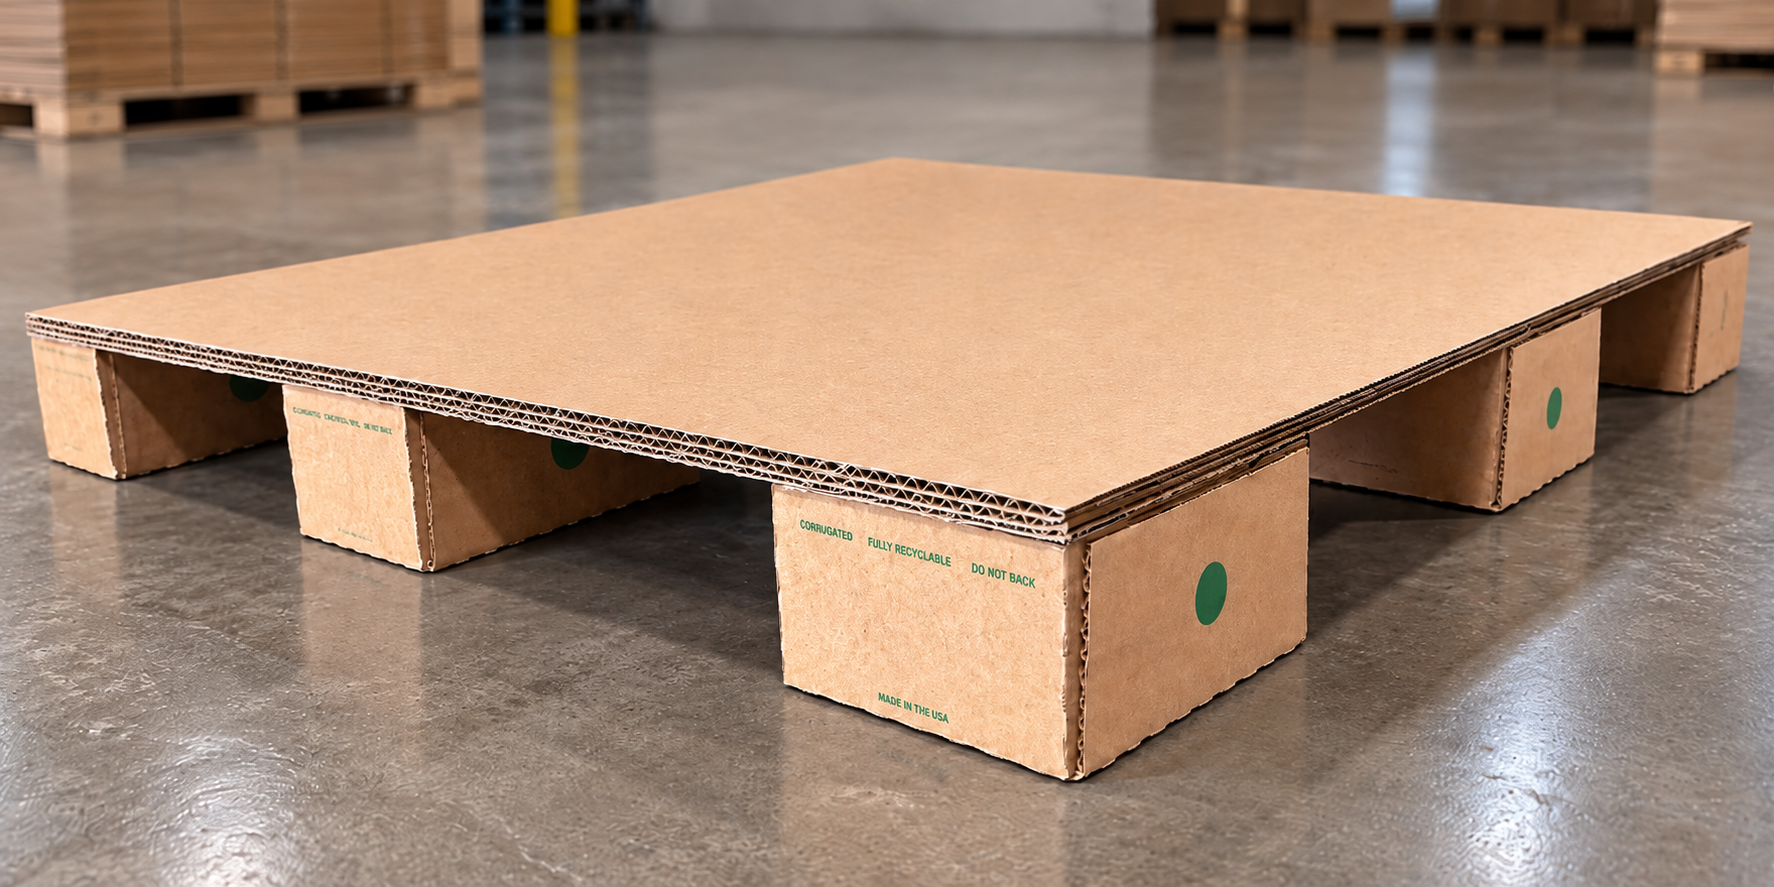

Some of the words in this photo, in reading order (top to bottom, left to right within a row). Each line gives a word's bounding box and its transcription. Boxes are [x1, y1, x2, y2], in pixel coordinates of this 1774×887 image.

[868, 537, 893, 551] FULLY
[895, 544, 951, 567] RECYCLABLE
[971, 563, 985, 575] DO
[988, 567, 1007, 581] NOT
[1009, 573, 1035, 588] BACK
[878, 692, 901, 707] MADE
[903, 701, 912, 712] IN
[914, 704, 930, 717] THE
[932, 710, 949, 723] USA
